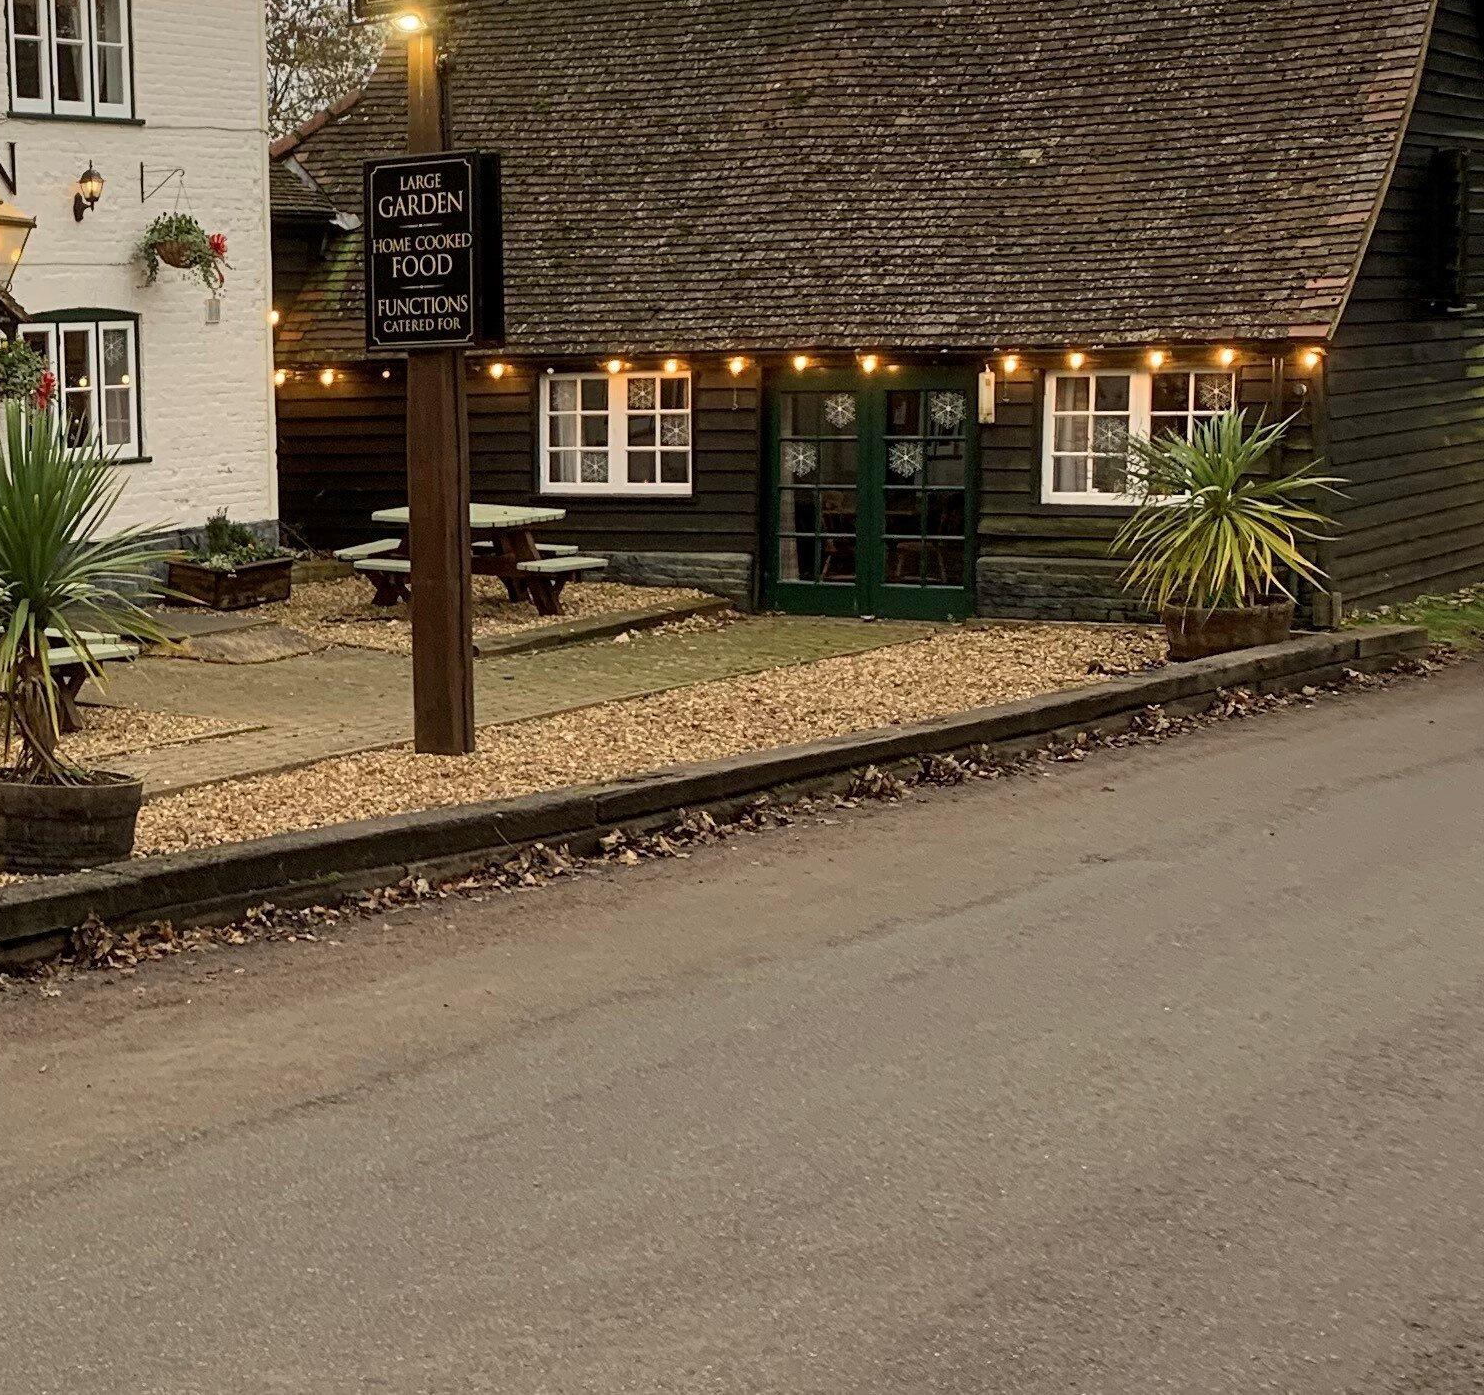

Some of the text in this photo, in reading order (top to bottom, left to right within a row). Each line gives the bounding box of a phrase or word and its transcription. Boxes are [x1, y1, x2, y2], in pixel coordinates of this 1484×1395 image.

[400, 173, 442, 191] LARGE
[378, 190, 464, 218] GARDEN
[372, 232, 473, 254] HOME COOKED
[392, 253, 453, 278] FOOD
[377, 294, 469, 317] FUNCTIONS
[383, 317, 461, 333] CATERED FOR
